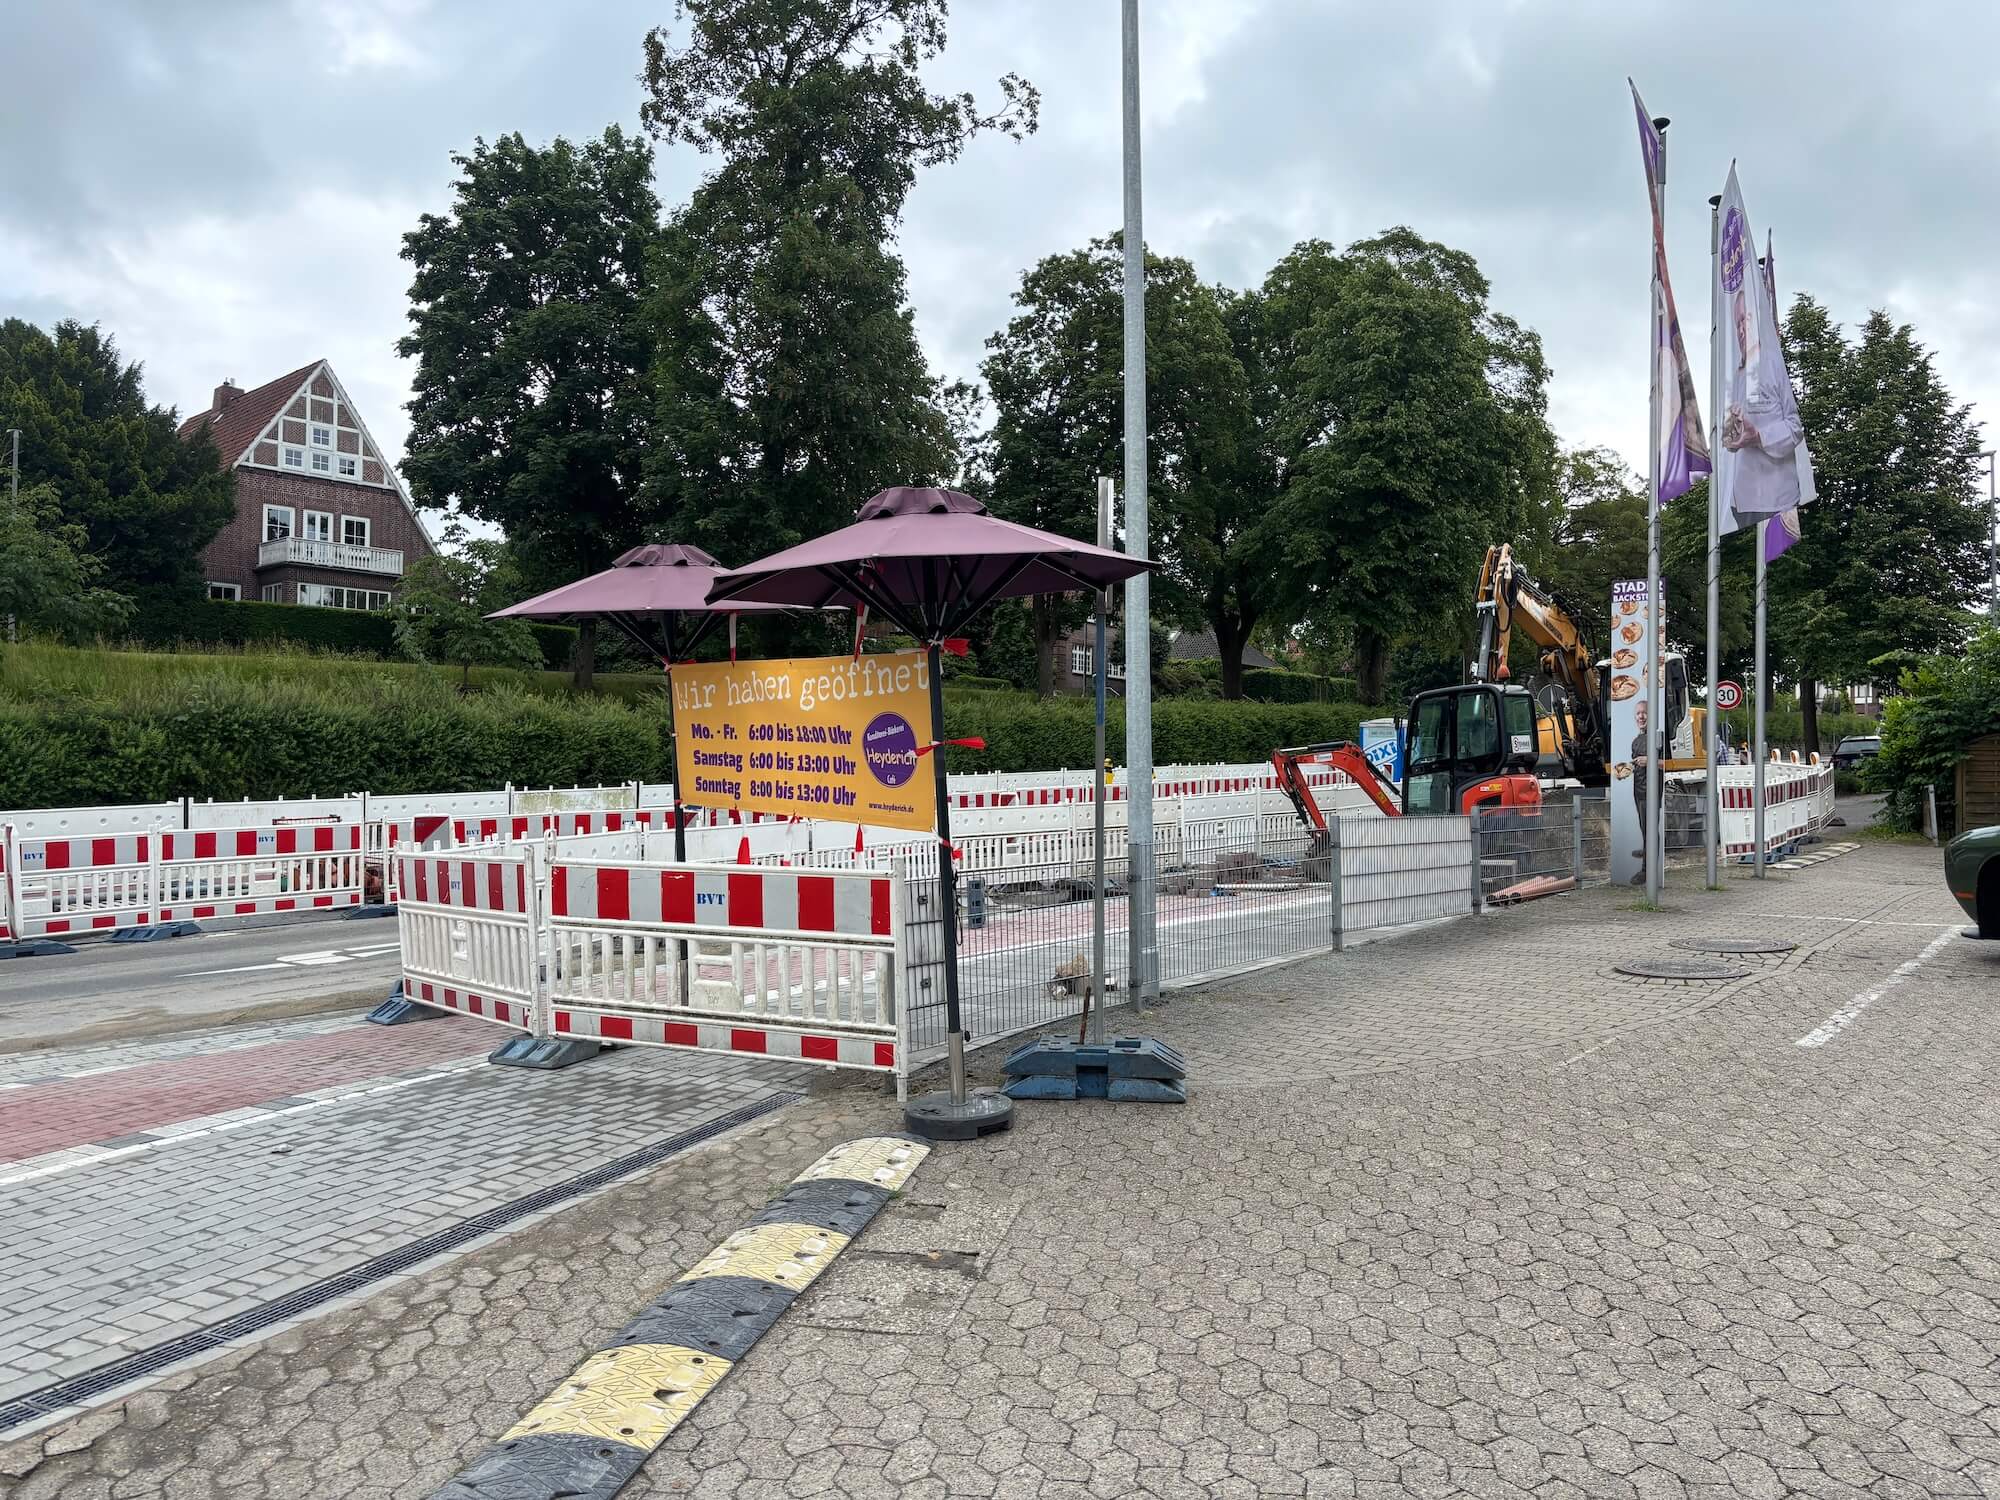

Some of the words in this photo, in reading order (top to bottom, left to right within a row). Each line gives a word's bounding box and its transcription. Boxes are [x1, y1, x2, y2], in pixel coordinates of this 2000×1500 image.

[1613, 580, 1664, 594] STADR
[674, 680, 716, 710] Wir
[725, 671, 792, 706] haben
[799, 654, 930, 711] geöffnet
[1718, 689, 1735, 702] 30
[691, 723, 714, 739] Mo.
[723, 723, 738, 740] Fr.
[749, 724, 774, 741] 6:00
[776, 723, 794, 742] bis
[796, 725, 827, 743] 18:00
[828, 725, 852, 745] Uhr
[693, 750, 743, 773] Samstag
[749, 752, 773, 770] 6:00
[776, 752, 794, 771] bis
[797, 754, 830, 773] 13:00
[833, 755, 856, 775] Uhr
[695, 776, 742, 800] Sonntag
[750, 780, 772, 798] 8:00
[775, 780, 794, 800] bis
[797, 784, 829, 803] 13:00
[833, 785, 856, 806] Uhr
[868, 802, 914, 813] www.heyderich.de
[24, 852, 44, 860] BVT
[696, 893, 726, 905] BVT
